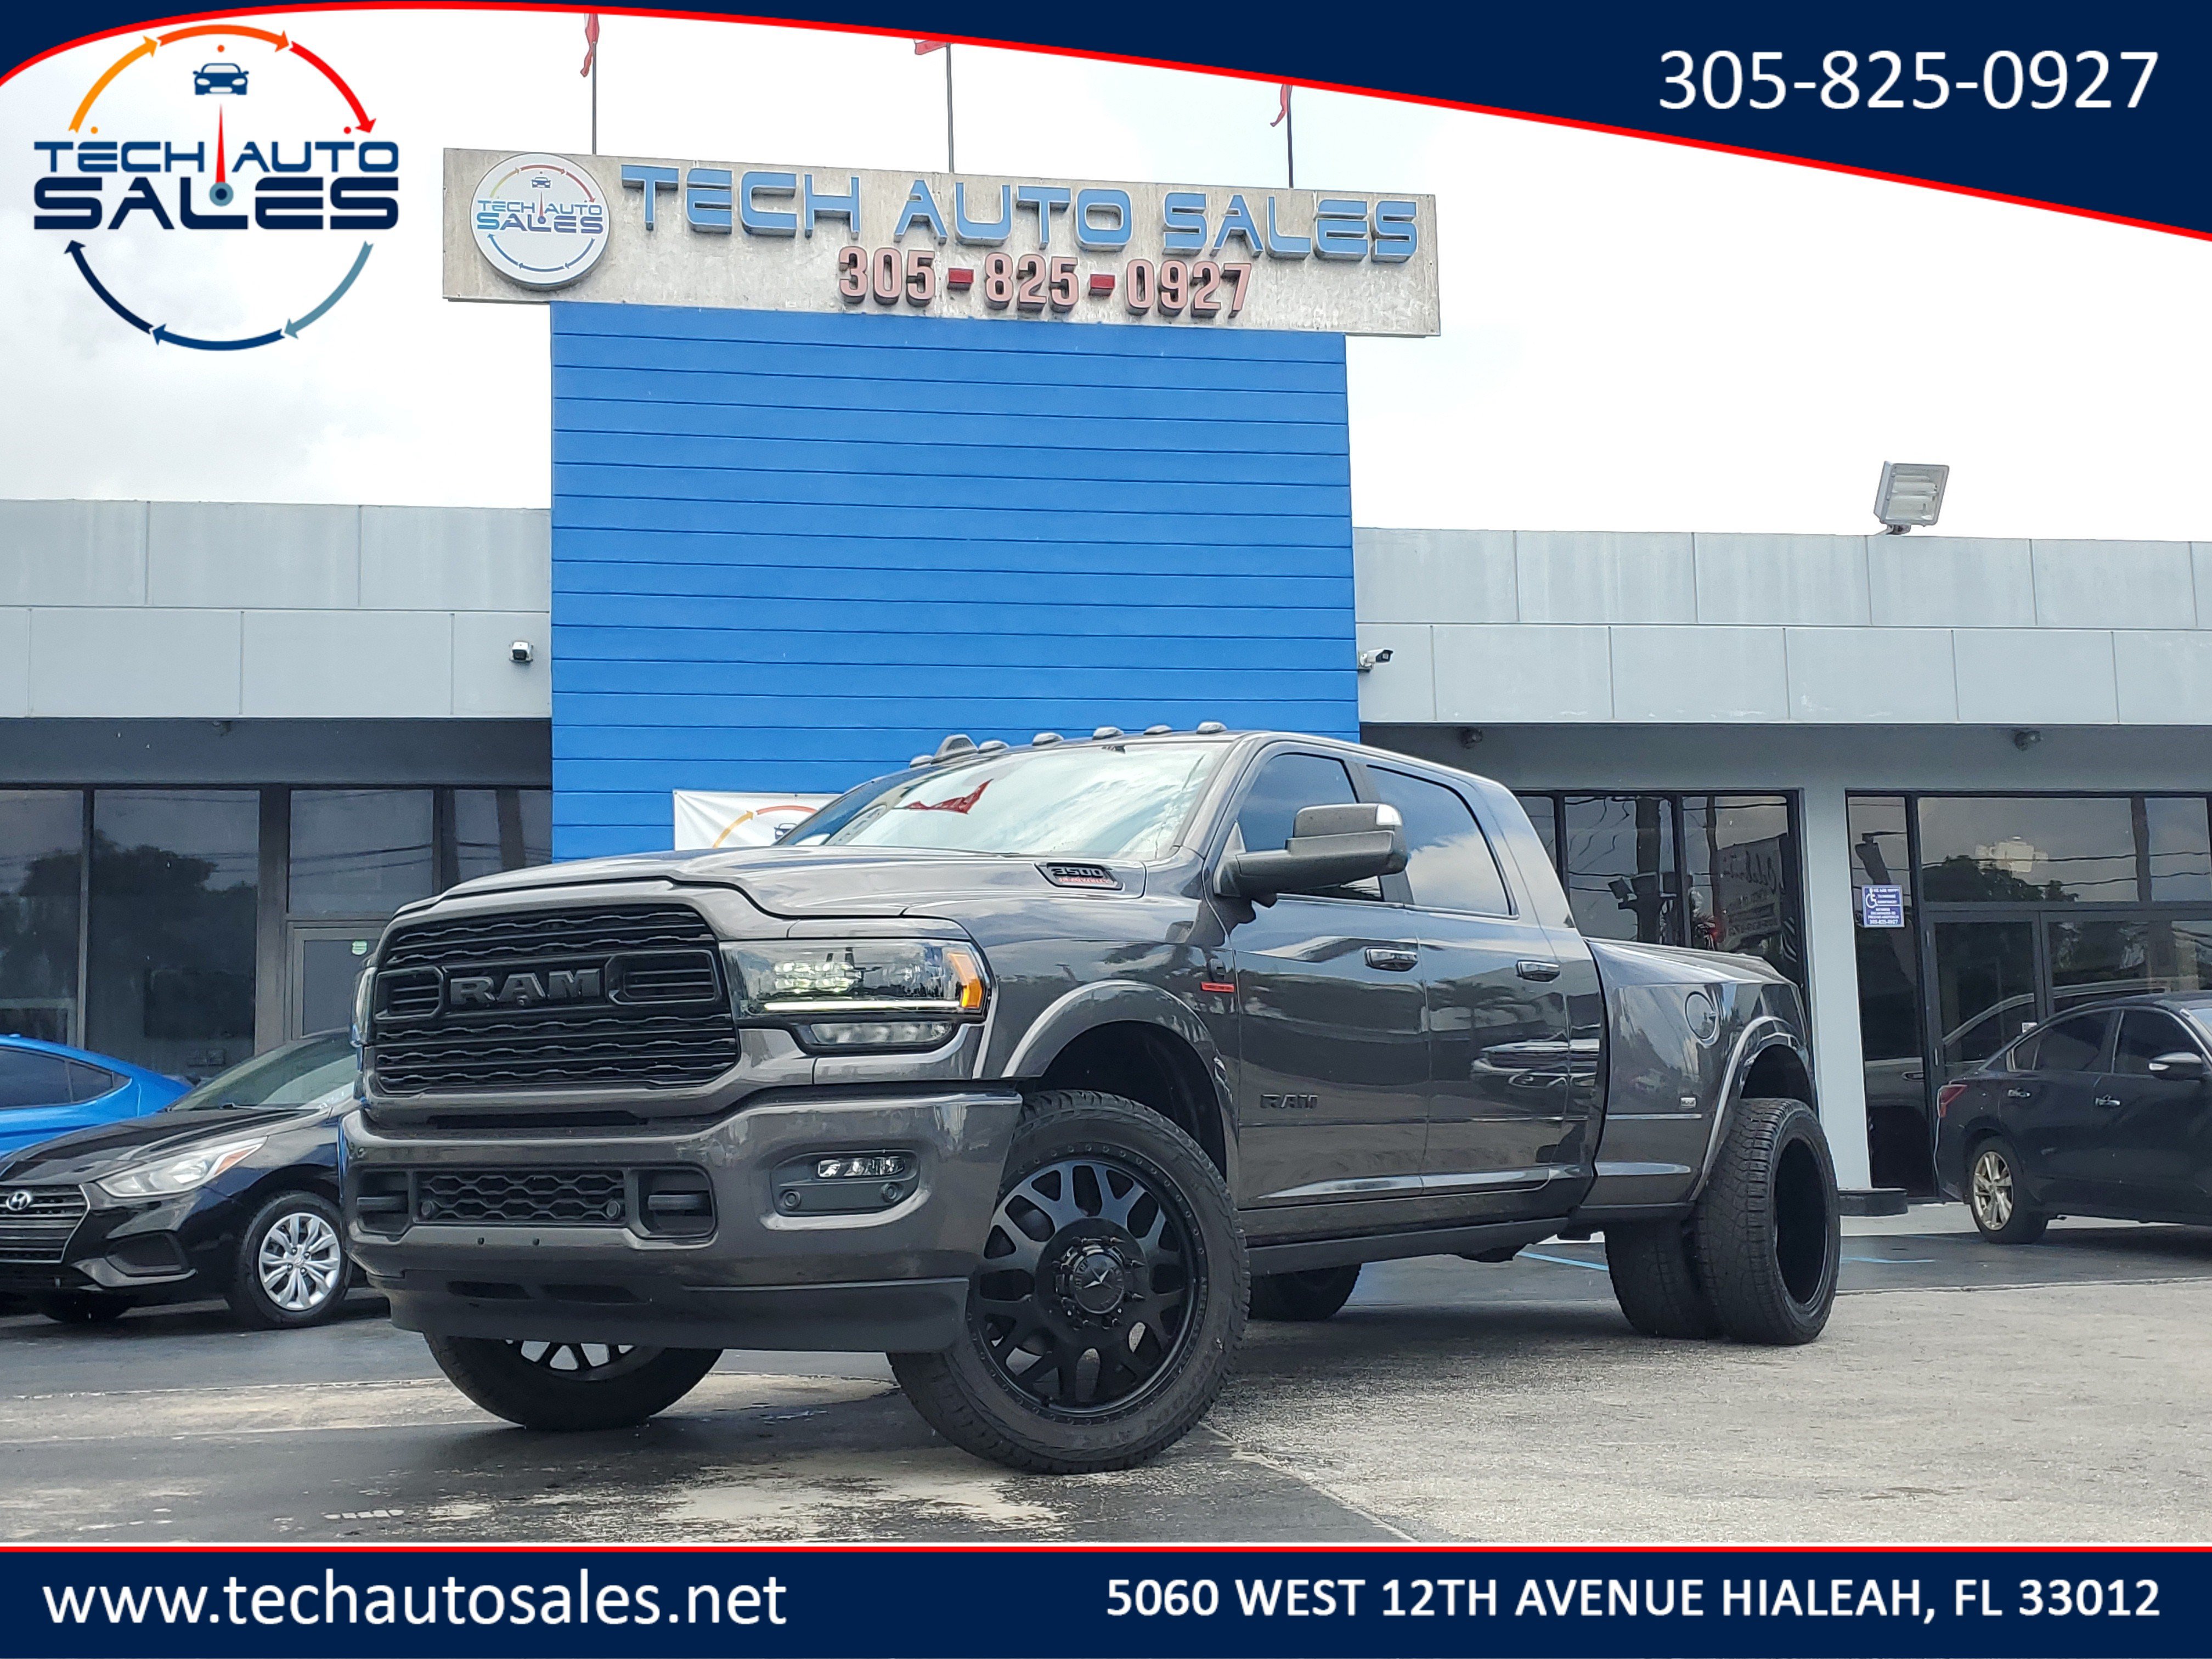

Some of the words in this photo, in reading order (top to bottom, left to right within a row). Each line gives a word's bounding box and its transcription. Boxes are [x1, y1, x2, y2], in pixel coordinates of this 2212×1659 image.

[477, 200, 535, 214] TECH
[544, 202, 603, 216] AUTO
[621, 164, 861, 240] TECH
[893, 178, 1133, 253] AUTO
[1162, 190, 1418, 263] SALES
[476, 212, 604, 234] SALES
[838, 245, 1253, 318] 305-825-0927
[1051, 867, 1104, 878] 3500
[450, 968, 601, 1005] RAM
[1260, 1093, 1318, 1109] RAM
